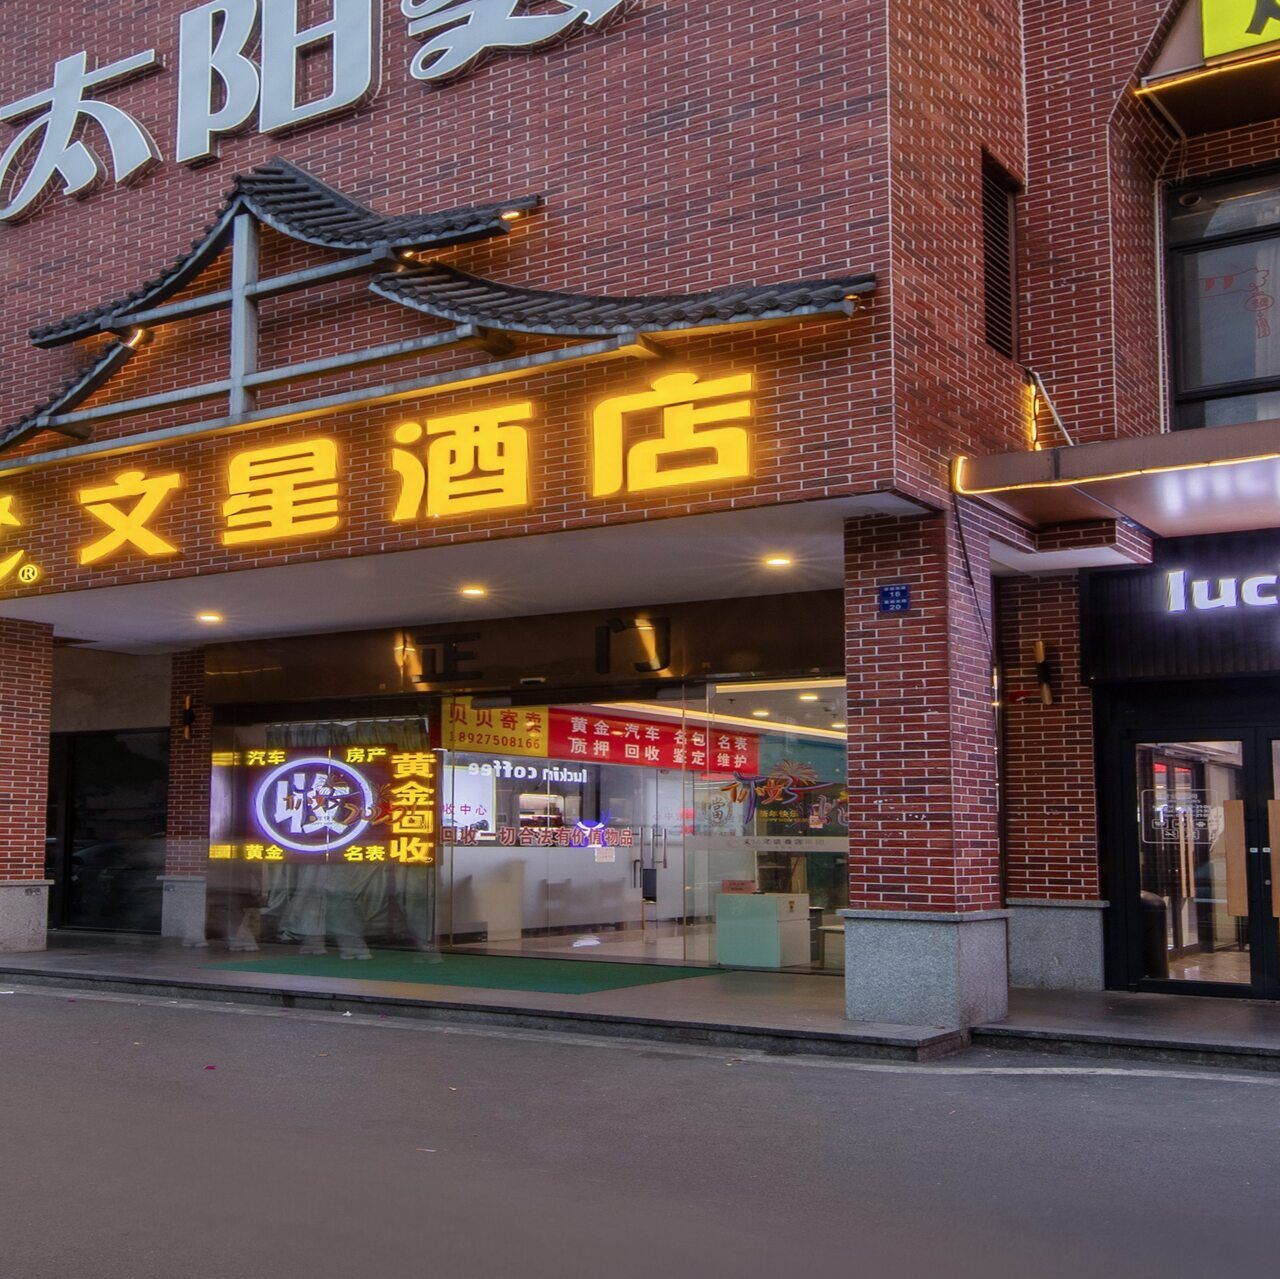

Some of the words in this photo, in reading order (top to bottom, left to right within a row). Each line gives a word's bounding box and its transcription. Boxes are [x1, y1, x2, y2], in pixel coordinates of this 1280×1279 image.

[78, 371, 754, 566] 文星酒店
[448, 702, 543, 734] 贝贝寄卖
[570, 716, 610, 736] 黄金
[624, 722, 660, 742] 汽车
[673, 728, 706, 748] 名包
[717, 735, 748, 751] 名表
[449, 731, 542, 750] 18927508166
[570, 737, 610, 757] 质押
[624, 743, 660, 762] 回收
[673, 746, 705, 766] 鉴定
[717, 752, 748, 768] 维护
[247, 750, 286, 766] 汽车
[346, 747, 387, 764] 房产
[389, 752, 437, 863] 黄金回收
[440, 825, 634, 847] 回收一切合法有价值物品
[245, 844, 284, 861] 黄金
[343, 844, 386, 862] 名表
